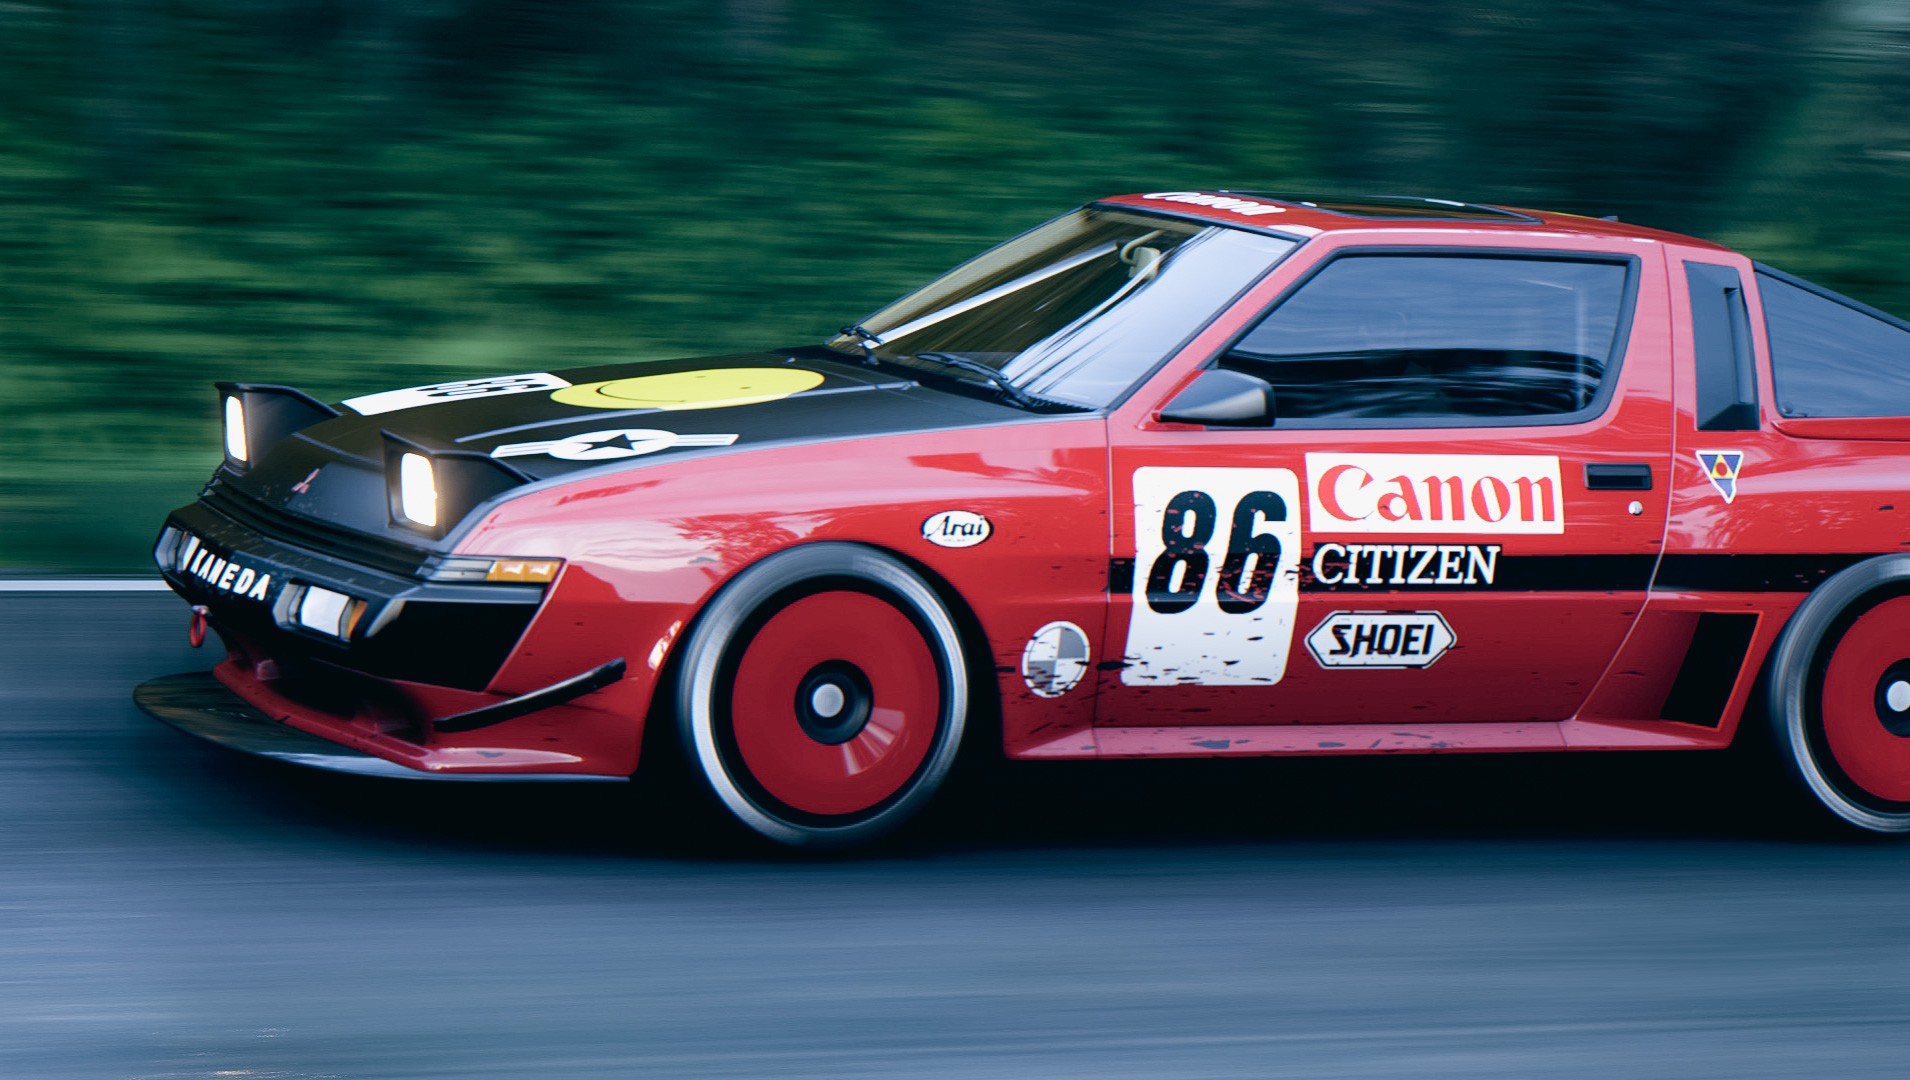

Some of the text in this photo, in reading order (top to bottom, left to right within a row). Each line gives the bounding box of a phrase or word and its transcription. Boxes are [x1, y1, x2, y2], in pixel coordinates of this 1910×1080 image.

[1317, 464, 1556, 522] Canon
[926, 516, 983, 536] Arai
[190, 548, 271, 601] KANEDA
[1145, 490, 1287, 614] 86
[1312, 543, 1501, 584] CITIZEN
[1329, 623, 1435, 657] SHOEI
